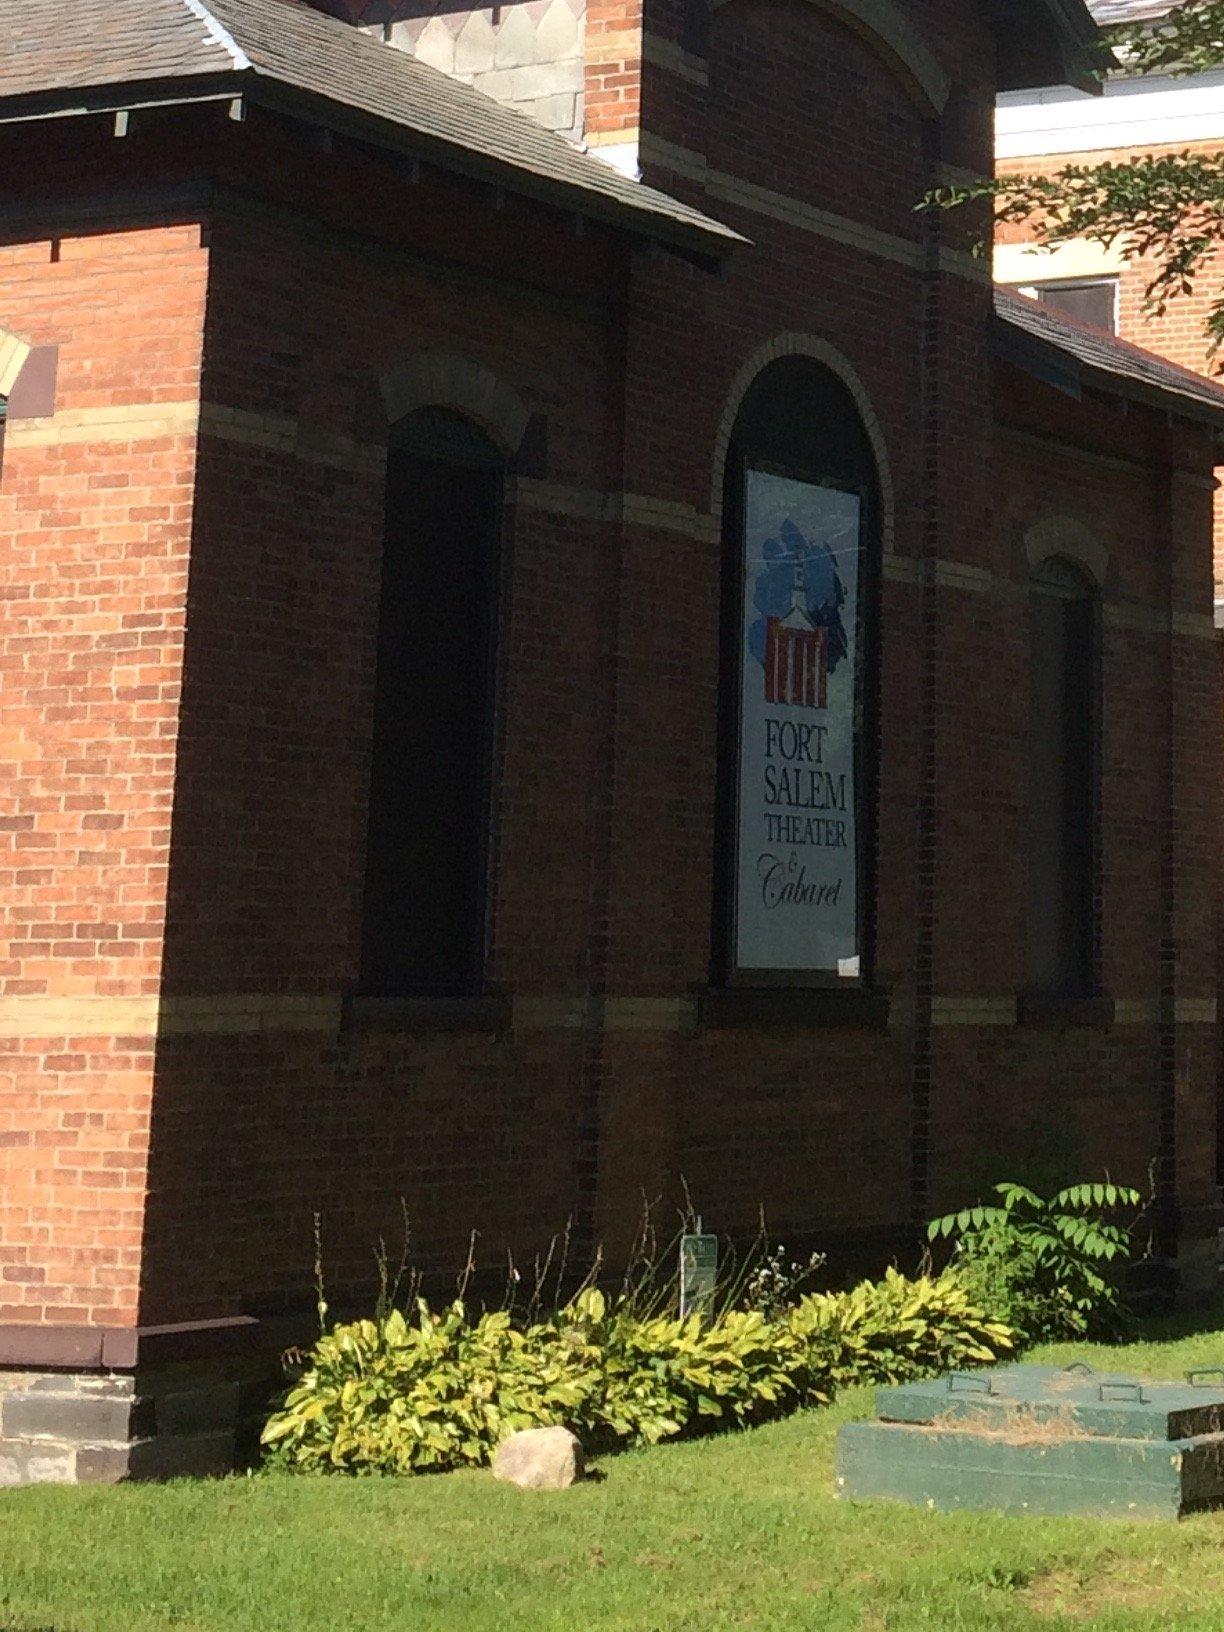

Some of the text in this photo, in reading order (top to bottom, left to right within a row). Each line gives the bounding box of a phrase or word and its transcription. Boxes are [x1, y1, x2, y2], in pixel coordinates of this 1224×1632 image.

[764, 718, 828, 763] FORT
[763, 765, 847, 811] SALEM
[764, 812, 847, 848] THEATER
[757, 853, 842, 909] Cabaret
